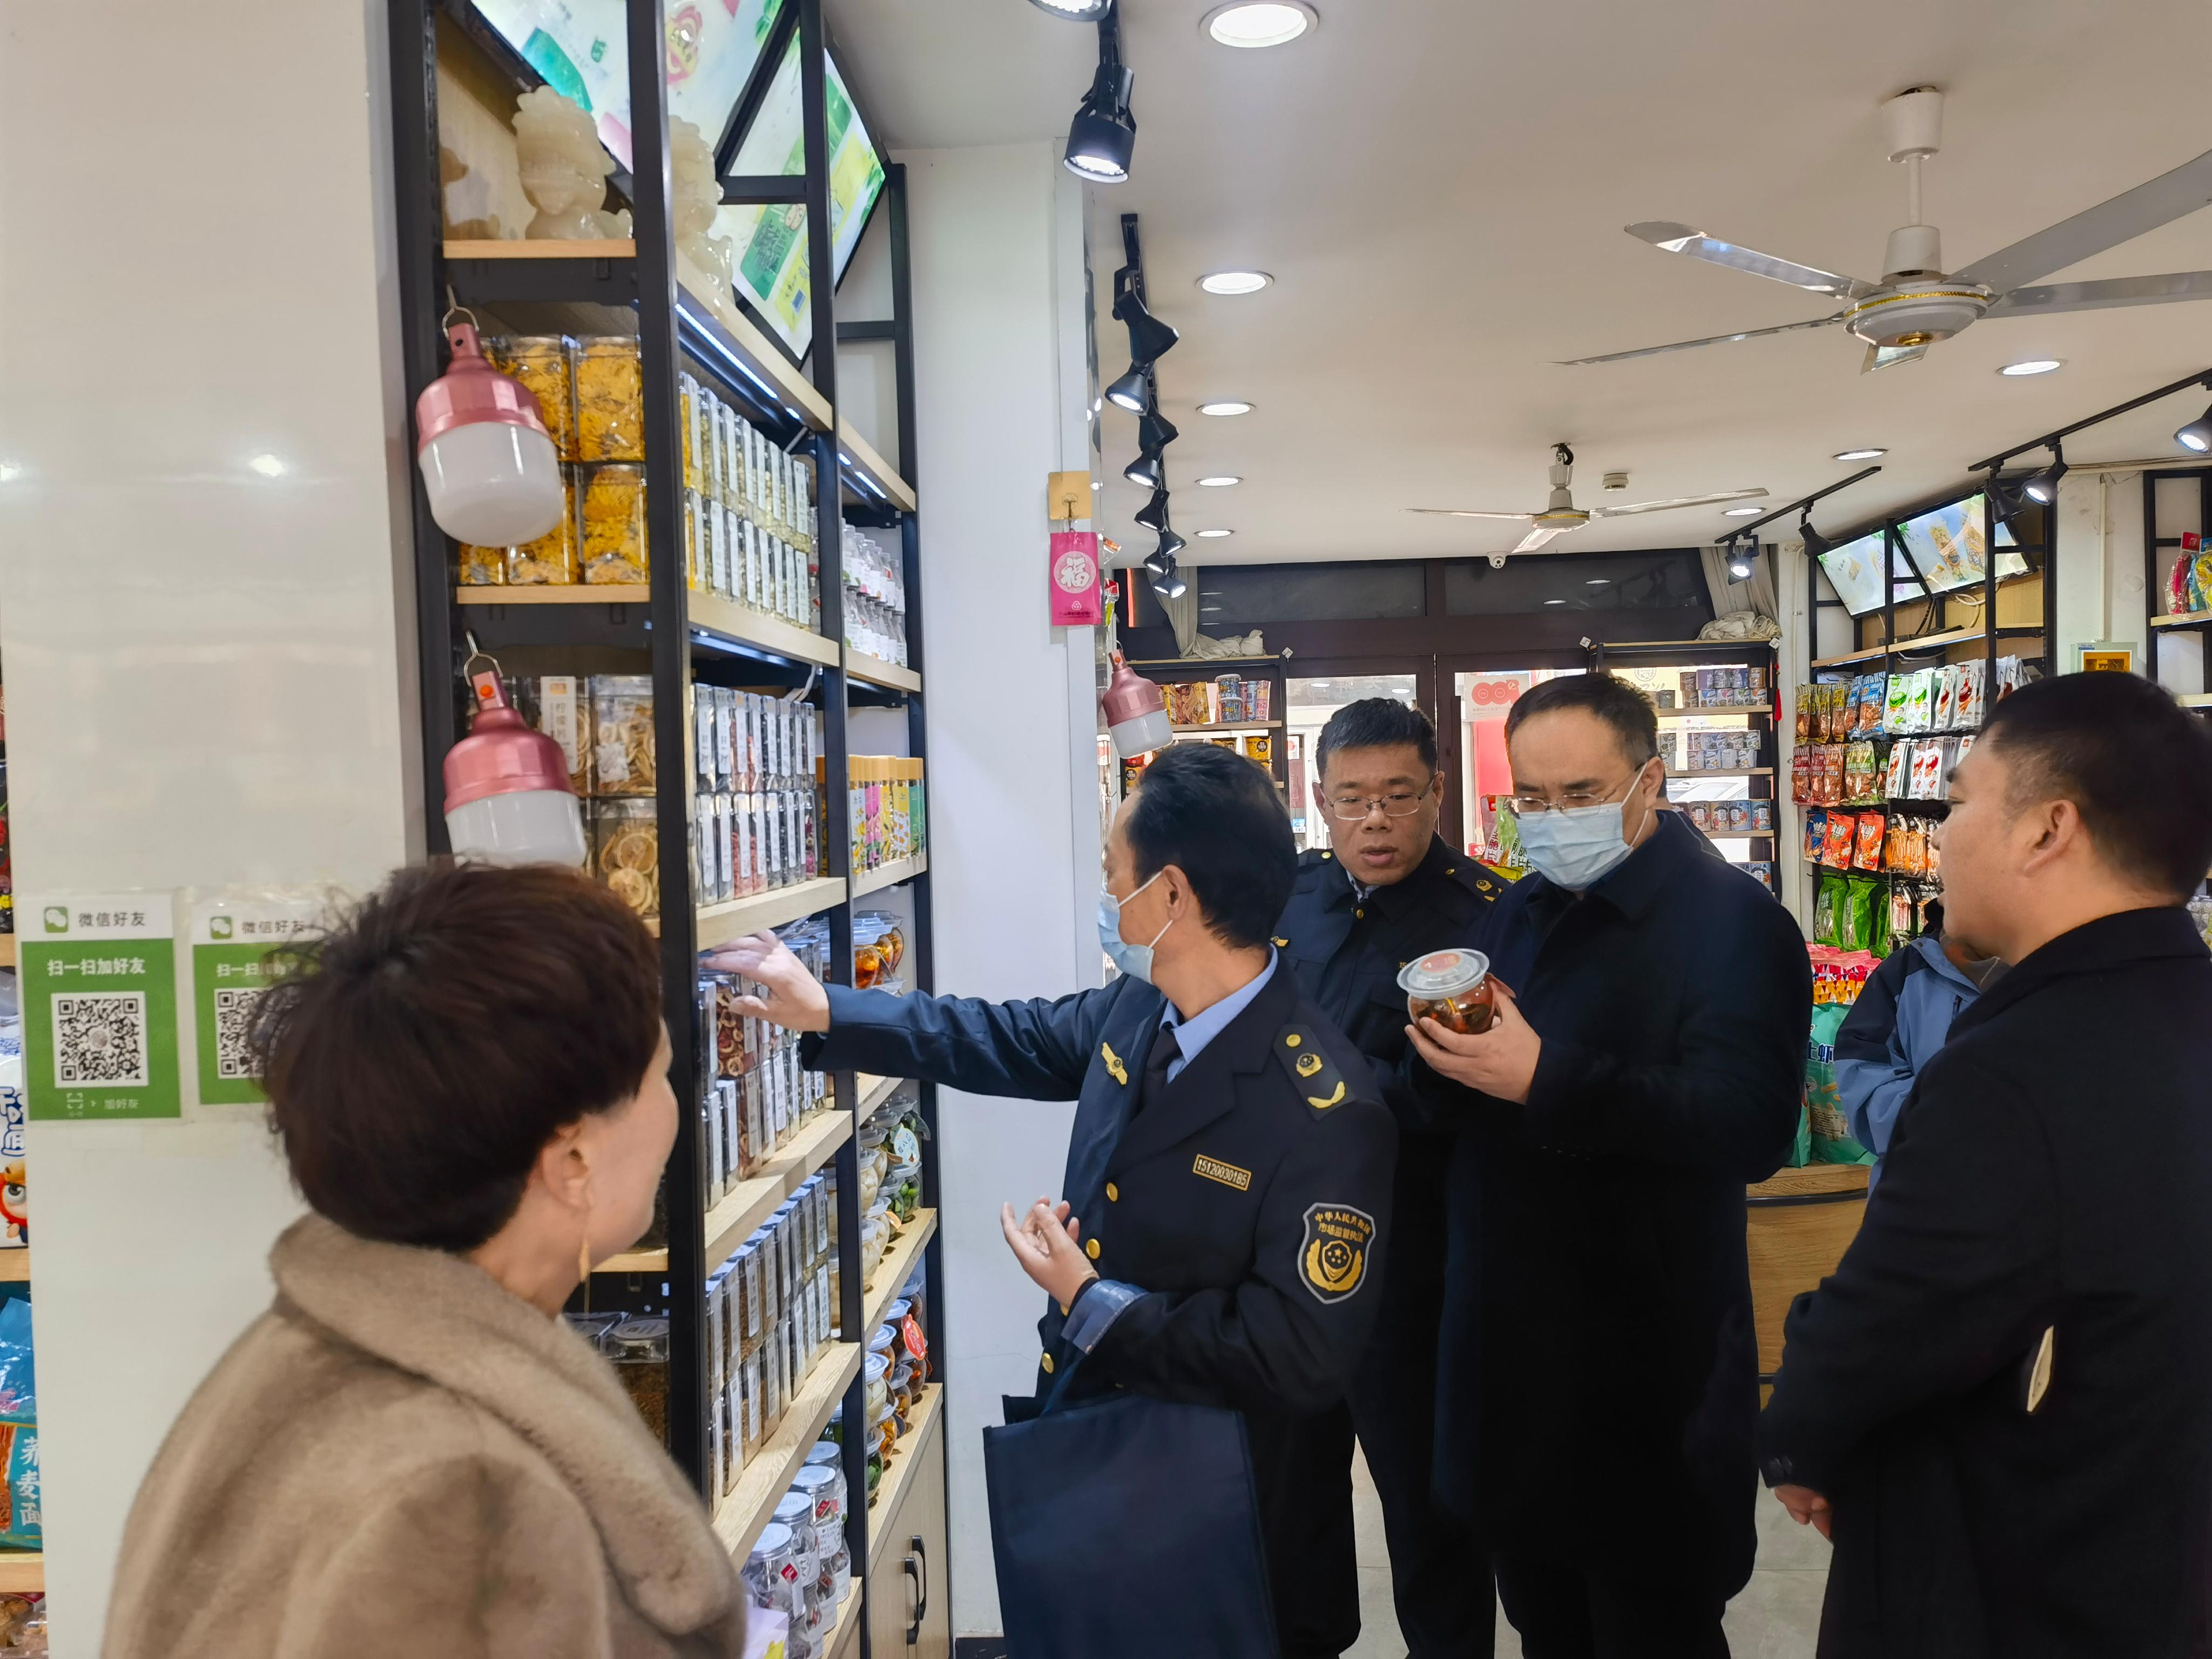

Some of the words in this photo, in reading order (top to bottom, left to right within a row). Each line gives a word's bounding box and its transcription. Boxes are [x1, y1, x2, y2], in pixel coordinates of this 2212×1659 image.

[1060, 557, 1090, 588] 福
[78, 912, 146, 927] 微信好友
[241, 920, 305, 934] 微信好友
[47, 957, 146, 977] 扫一扫加好友
[104, 1098, 139, 1110] 加好友
[1197, 1158, 1247, 1186] 15120030185
